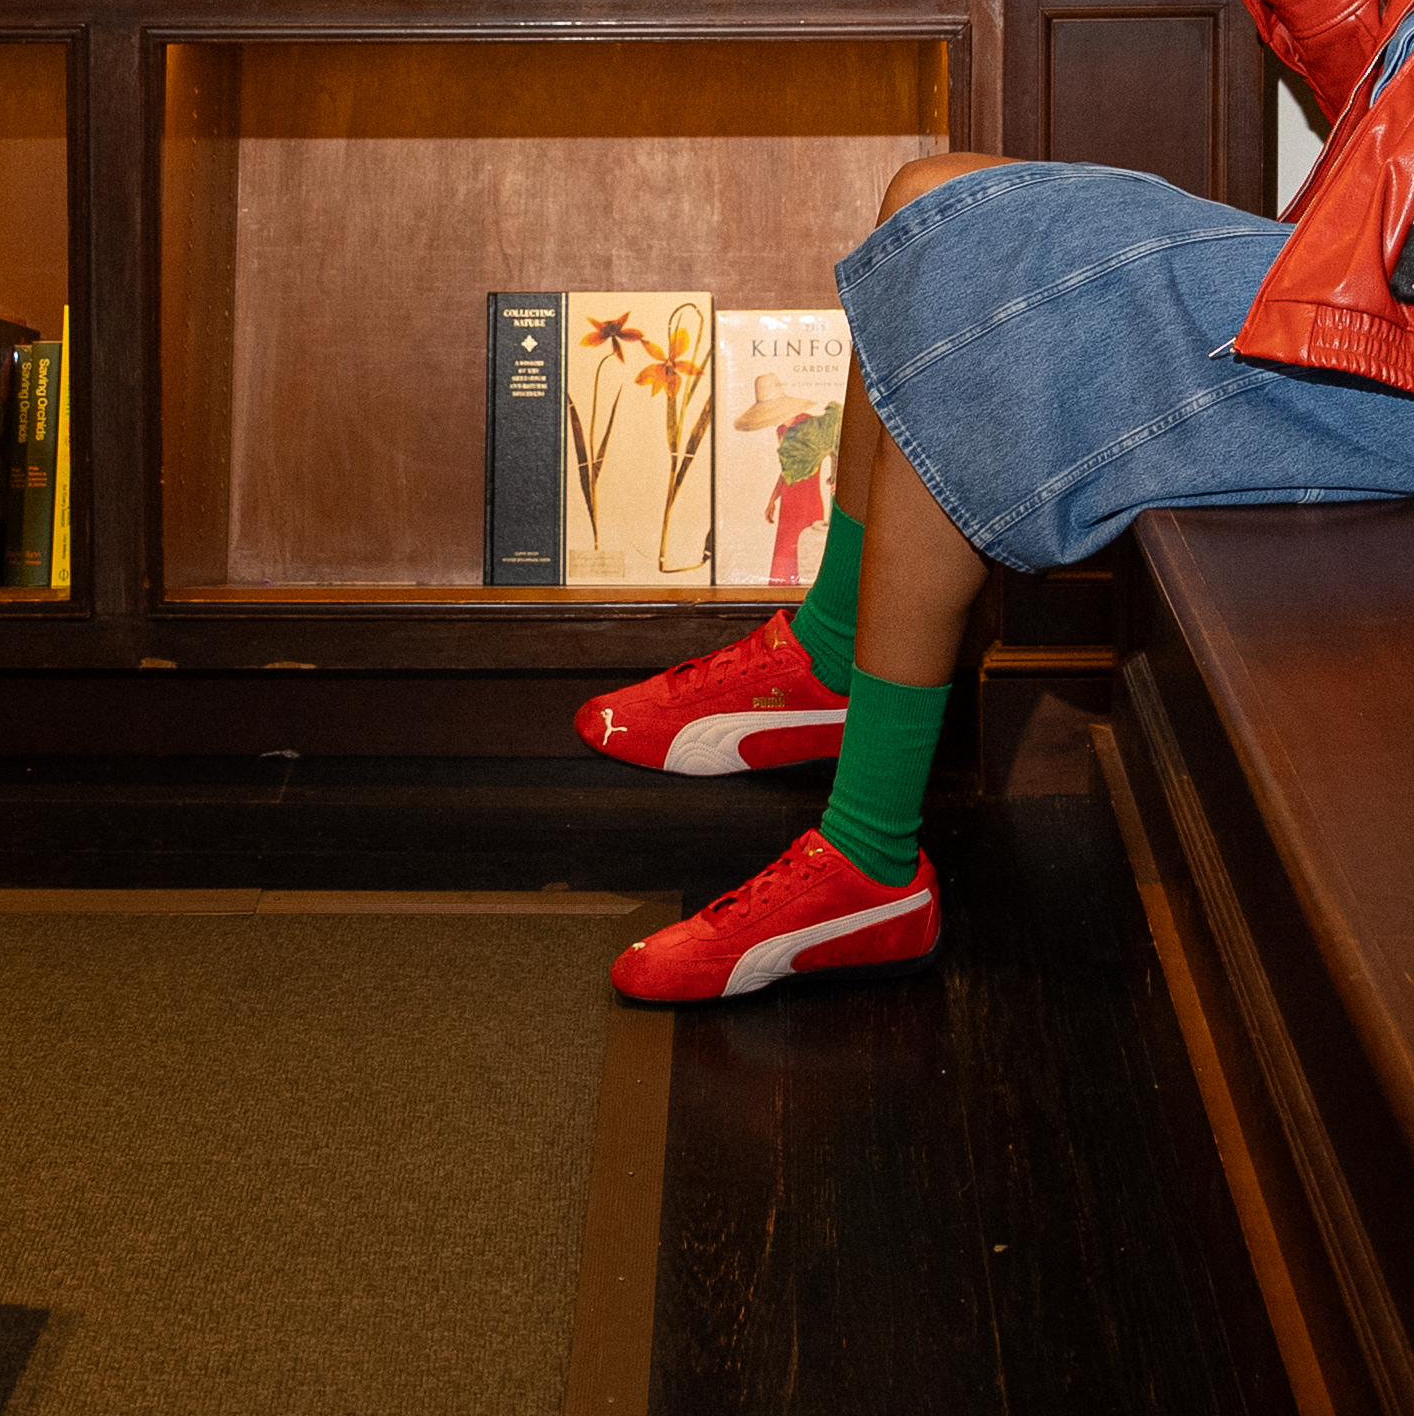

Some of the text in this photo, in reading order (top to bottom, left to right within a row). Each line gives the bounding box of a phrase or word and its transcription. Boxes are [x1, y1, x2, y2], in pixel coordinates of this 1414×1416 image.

[503, 309, 555, 318] COLLECTING
[514, 319, 546, 328] NATURE
[751, 339, 853, 357] KINFO
[793, 365, 839, 373] GARDEN
